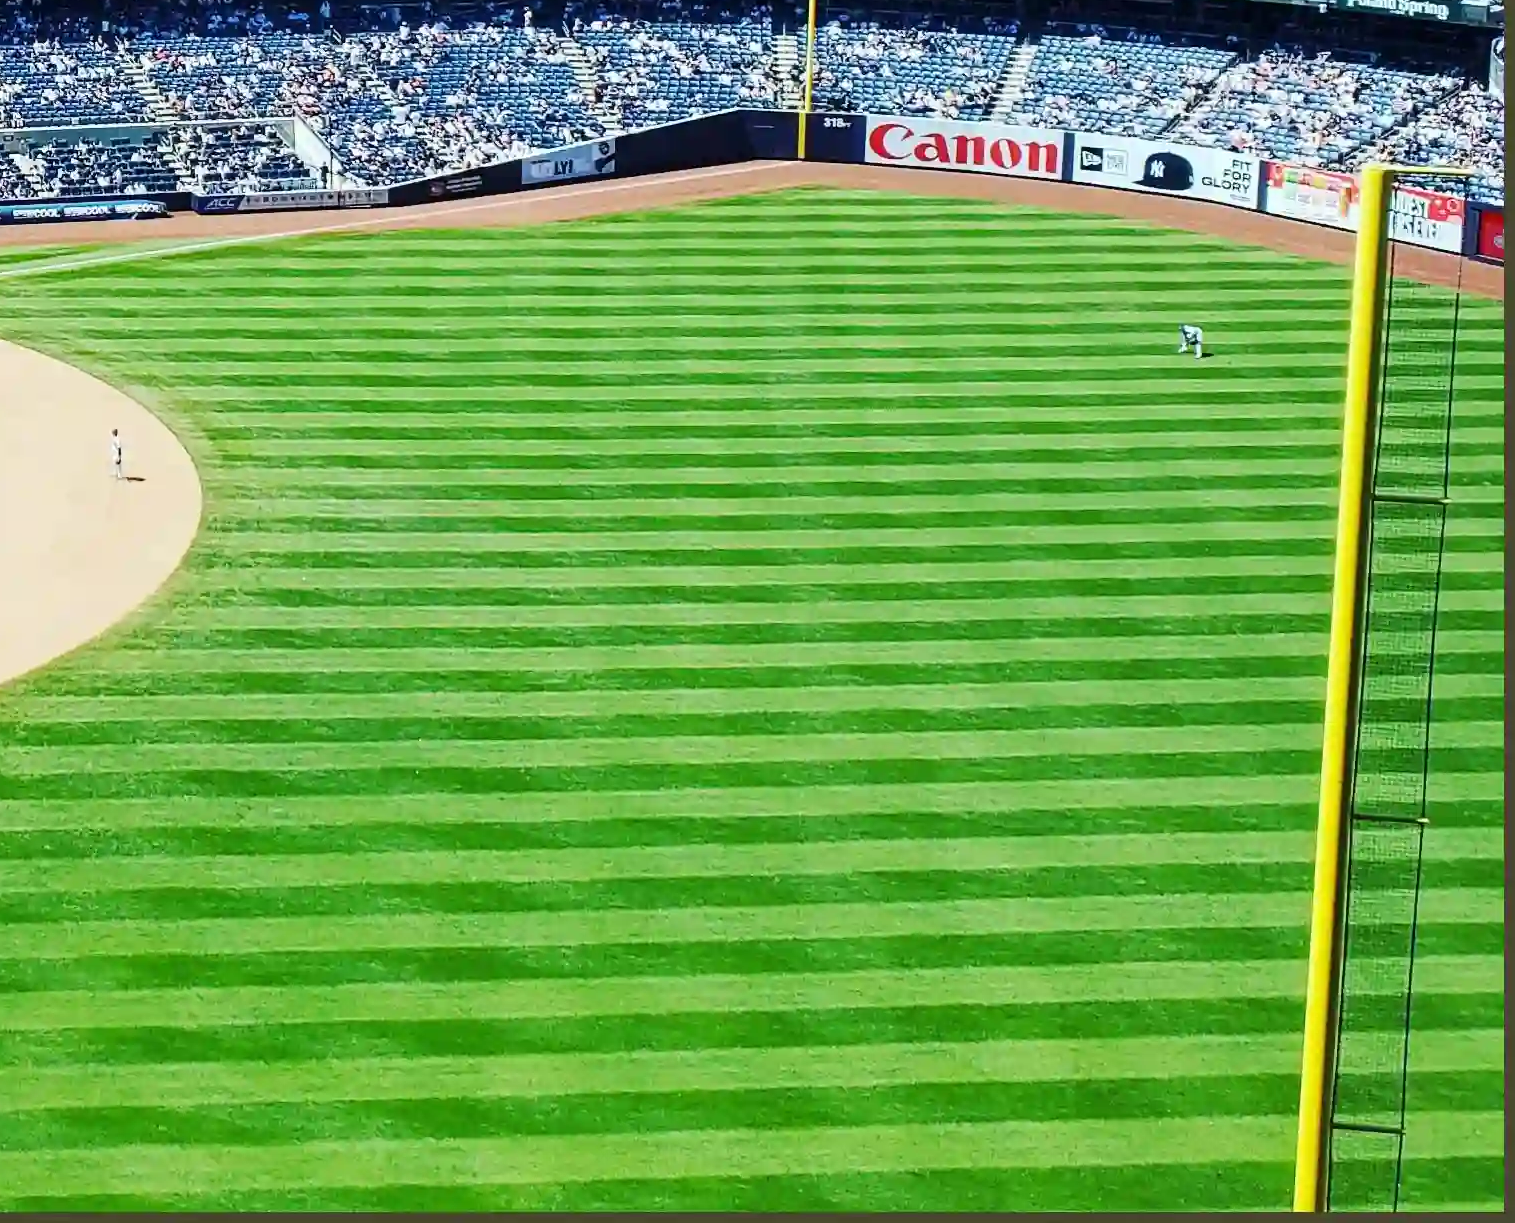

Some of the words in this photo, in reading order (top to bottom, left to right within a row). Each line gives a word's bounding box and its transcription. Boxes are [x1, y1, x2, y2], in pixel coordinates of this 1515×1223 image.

[869, 122, 1060, 174] Canon
[1232, 159, 1253, 172] FIT
[1223, 168, 1252, 182] FOR
[1201, 177, 1250, 194] GLORY
[206, 198, 237, 208] ACC
